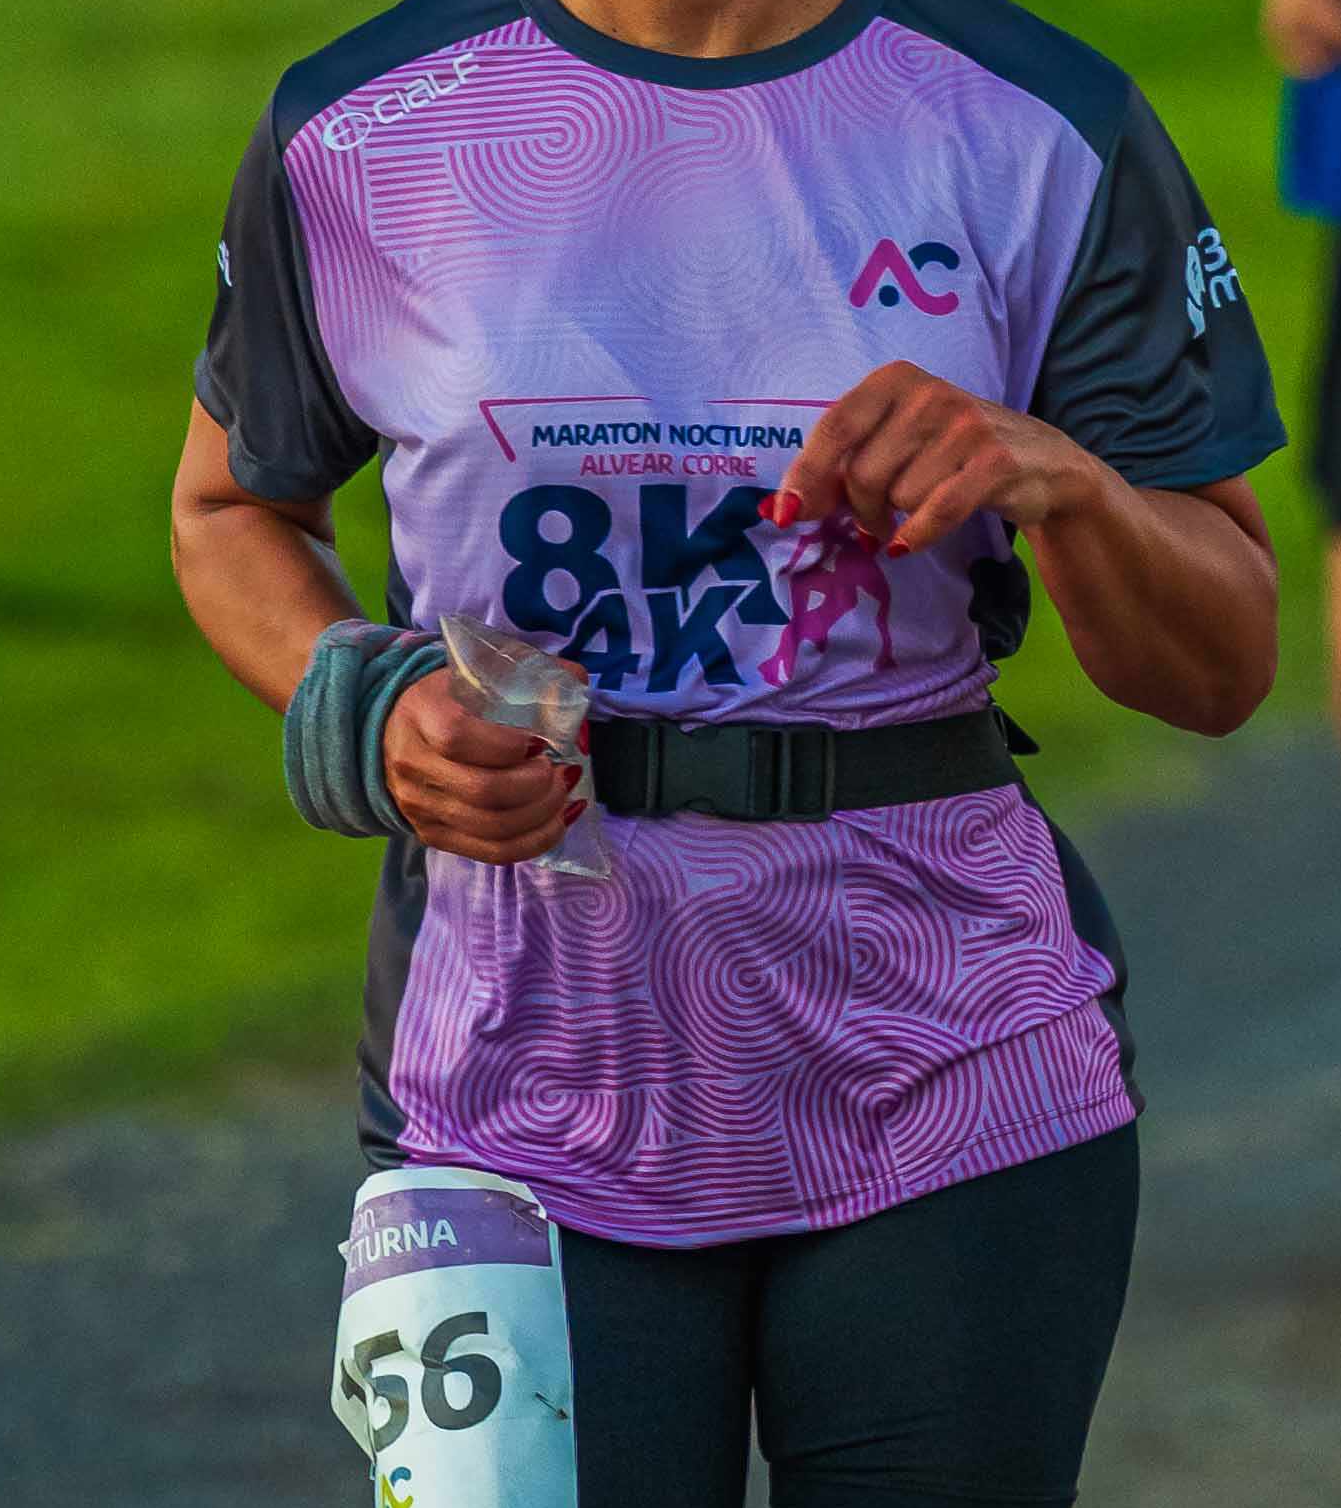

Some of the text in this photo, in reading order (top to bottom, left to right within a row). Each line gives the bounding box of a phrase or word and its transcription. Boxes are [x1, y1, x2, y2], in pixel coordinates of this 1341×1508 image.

[850, 238, 960, 316] AC
[532, 422, 804, 449] MARATON NOCTURNA
[580, 453, 757, 478] ALVEAR CORRE
[499, 484, 792, 638] 8K
[559, 585, 747, 693] 4K
